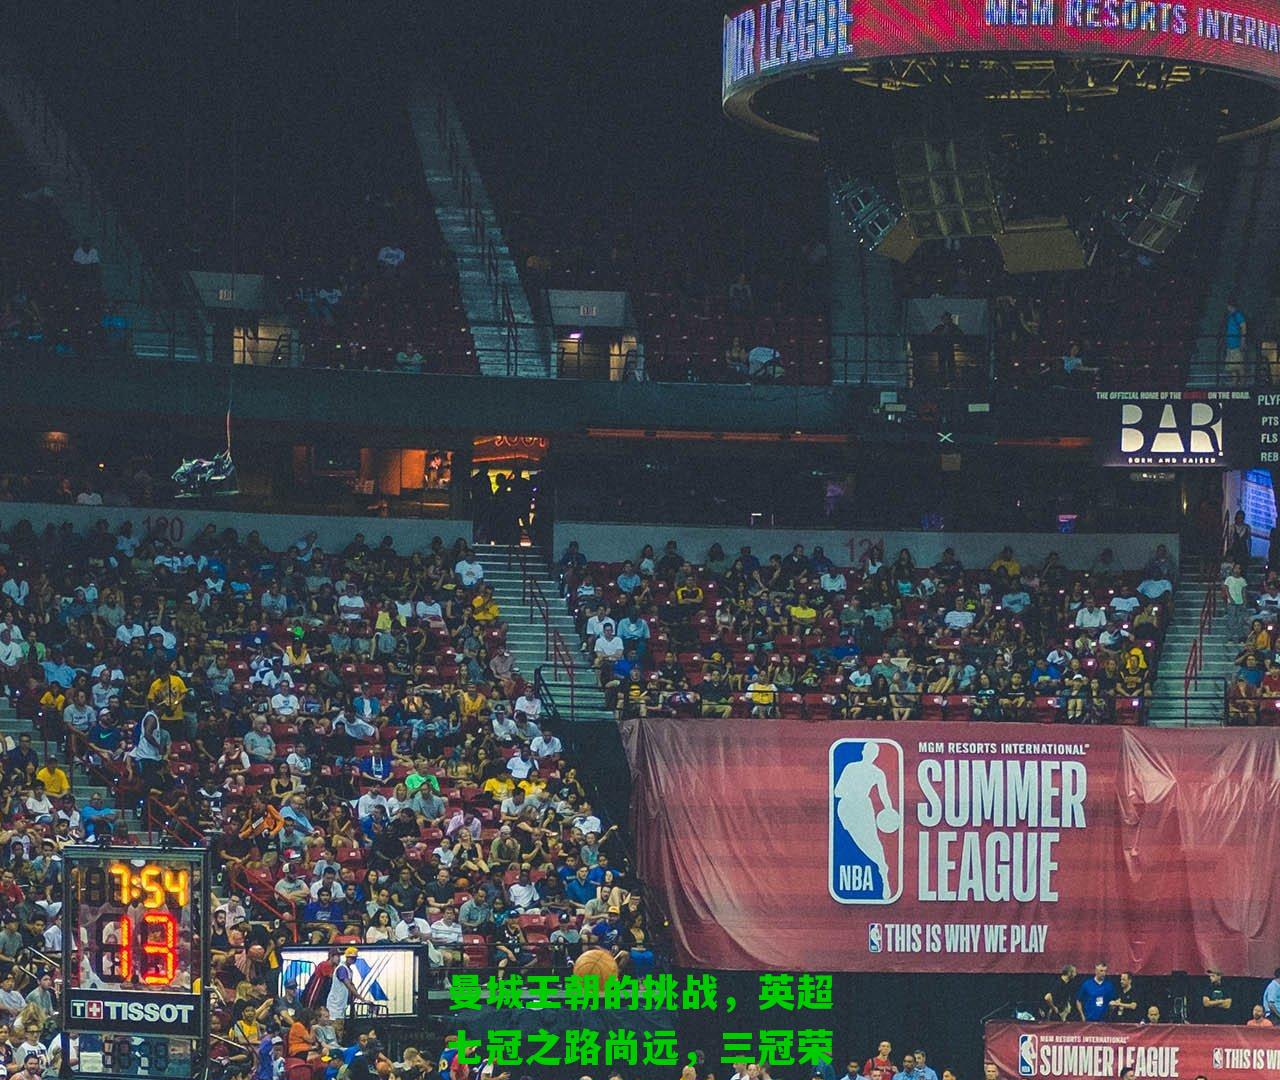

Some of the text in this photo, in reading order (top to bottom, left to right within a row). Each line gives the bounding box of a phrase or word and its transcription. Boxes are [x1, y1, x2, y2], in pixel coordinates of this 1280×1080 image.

[1065, 0, 1187, 34] RESORTS
[760, 0, 853, 70] LEAGUE
[1096, 391, 1108, 400] THE
[1110, 391, 1138, 400] OFFICIAL
[1170, 391, 1182, 400] THE
[1219, 391, 1230, 400] THE
[1261, 416, 1279, 426] PTS
[1261, 433, 1278, 443] FLS
[1261, 452, 1278, 462] REB
[919, 742, 1086, 755] MGM RESORTS INTERNATIONAL
[917, 759, 1087, 828] SUMMER
[839, 865, 874, 891] NBA
[919, 831, 1060, 902] LEAGUE
[109, 863, 189, 908] 7:54
[120, 913, 178, 986] 13
[885, 924, 1048, 953] THIS IS WHY WE PLAY
[104, 1002, 194, 1023] TISSOT
[1040, 1045, 1114, 1077] SUMMER
[1225, 1049, 1251, 1069] THIS
[1252, 1049, 1265, 1069] IS
